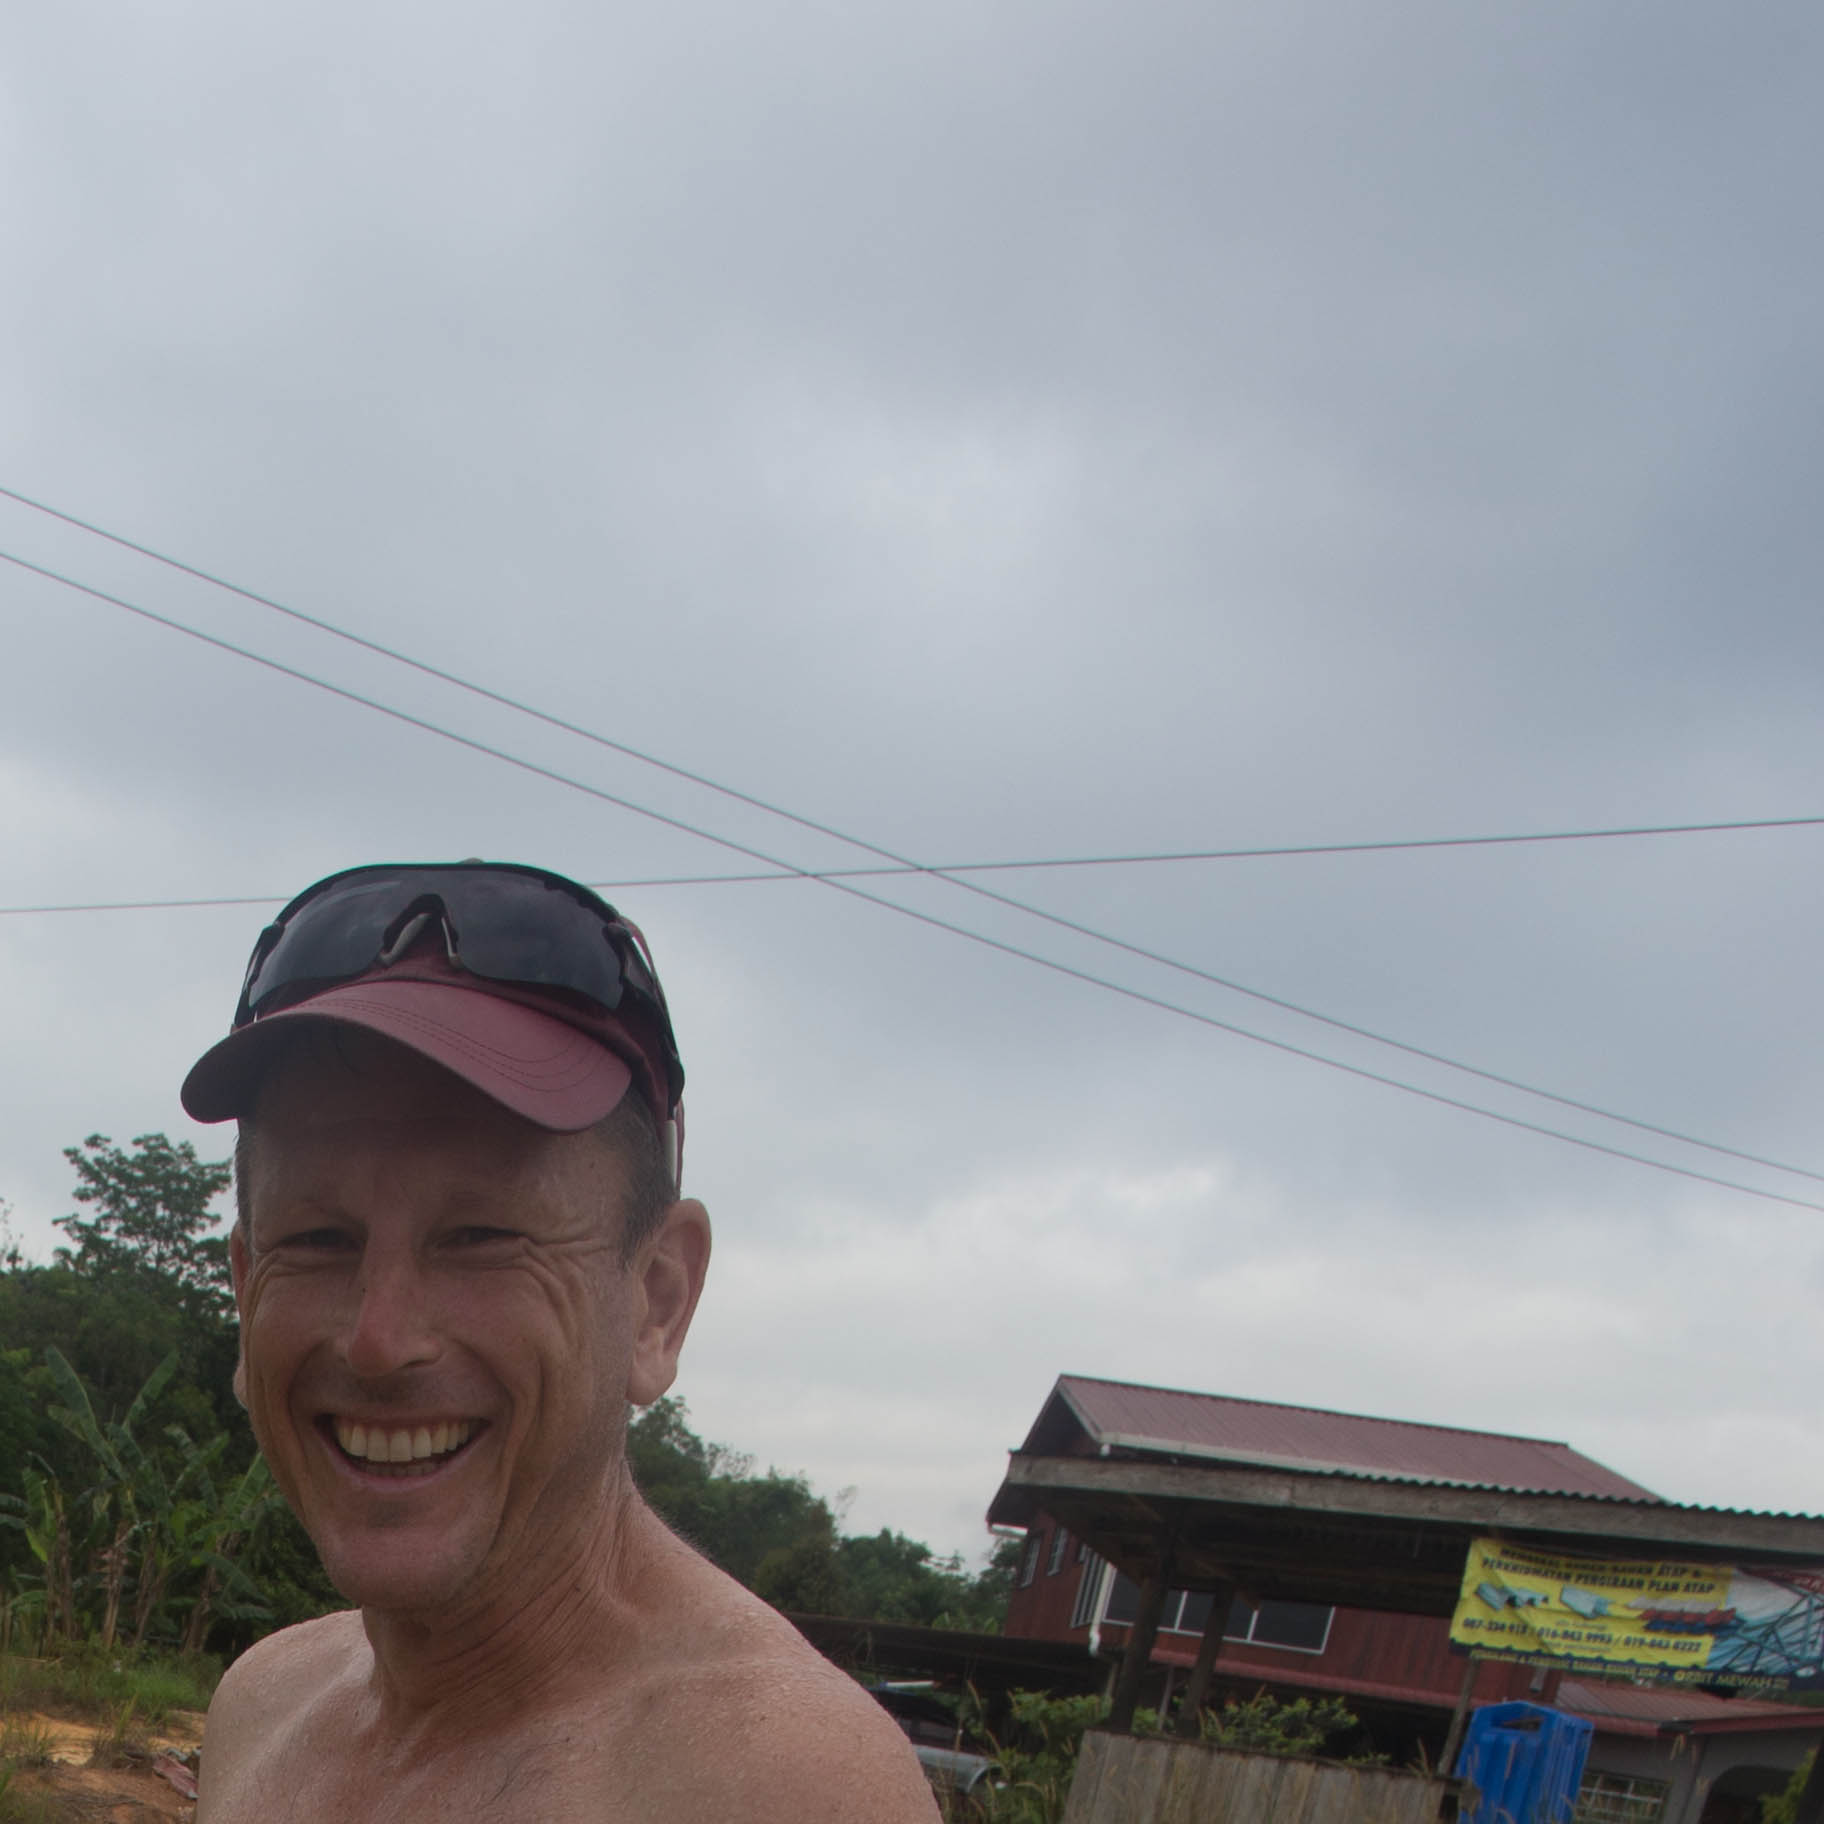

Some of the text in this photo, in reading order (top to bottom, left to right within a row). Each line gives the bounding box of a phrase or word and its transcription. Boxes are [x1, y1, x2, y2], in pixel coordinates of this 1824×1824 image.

[1482, 1556, 1572, 1582] PERKHIDMATAN
[1648, 1579, 1680, 1593] PLAN
[1683, 1581, 1716, 1594] ATAP
[1715, 1673, 1773, 1689] MEWAH
